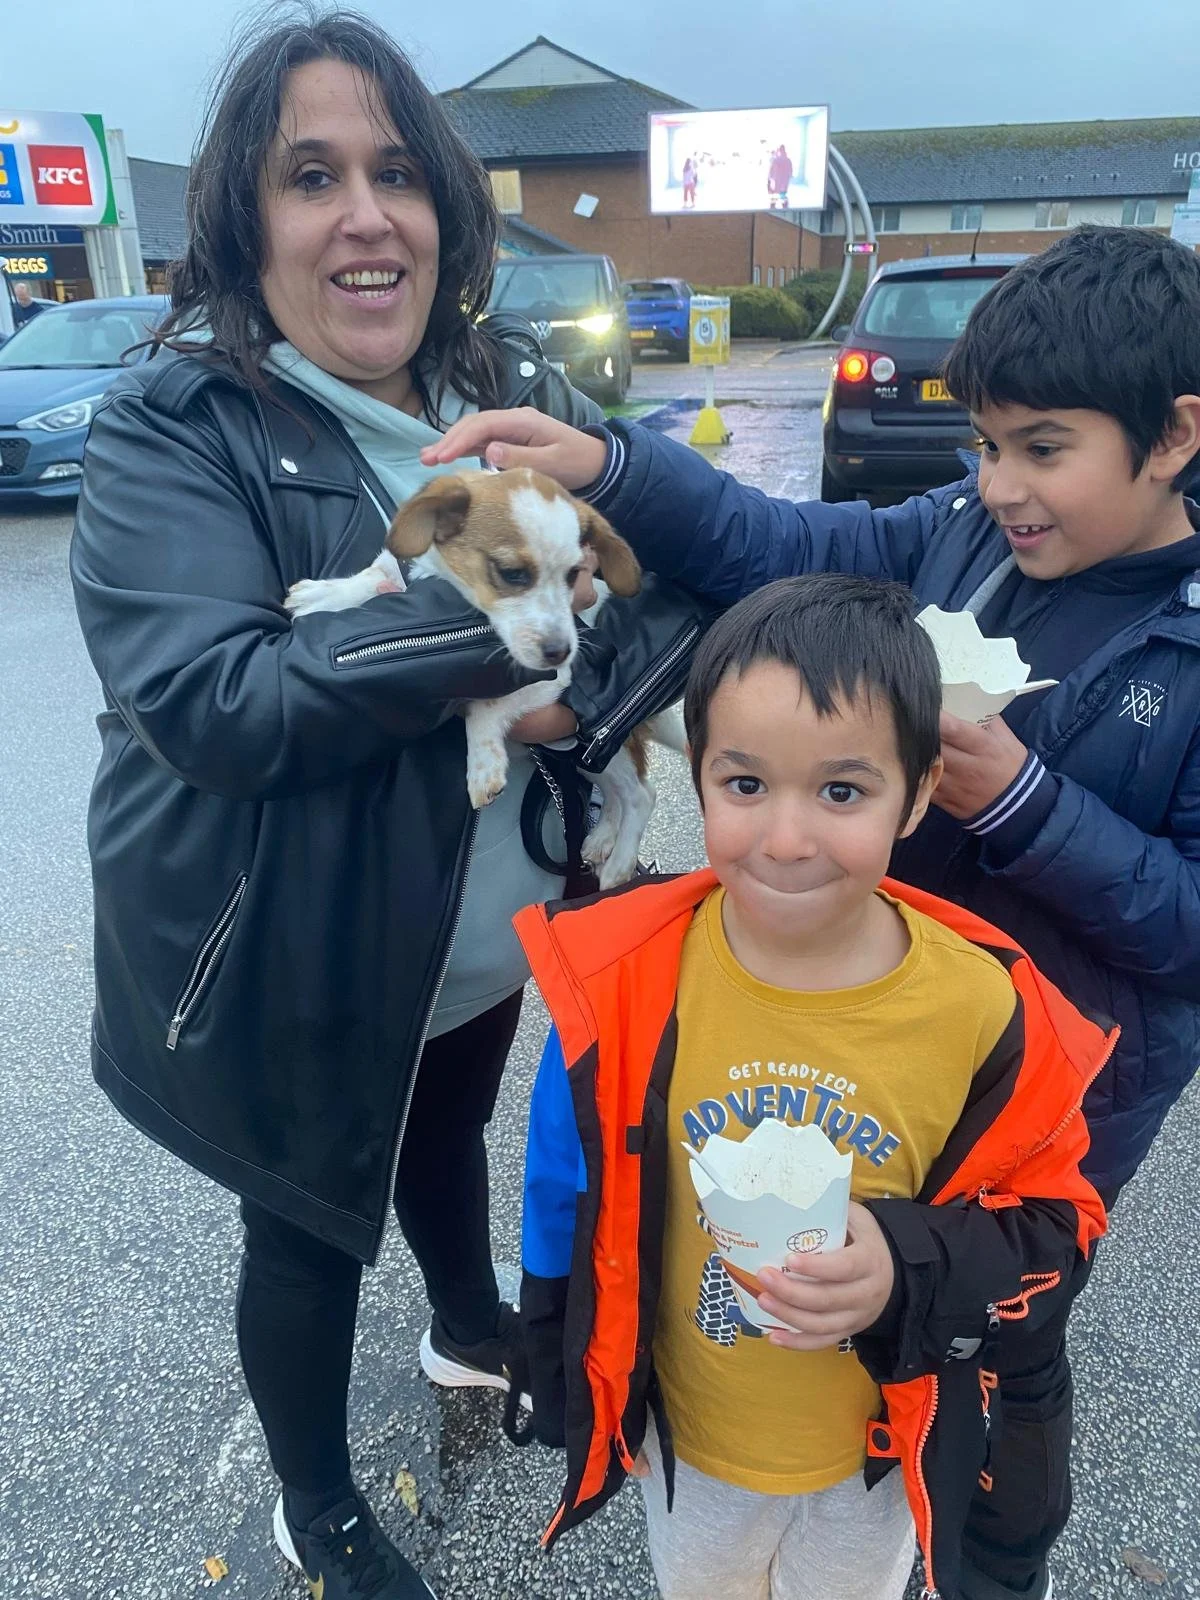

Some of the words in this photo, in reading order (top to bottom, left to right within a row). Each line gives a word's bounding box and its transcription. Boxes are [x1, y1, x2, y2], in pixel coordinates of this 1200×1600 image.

[38, 167, 84, 185] KFC
[1, 223, 58, 244] Smith
[728, 1061, 761, 1081] GET
[767, 1061, 820, 1082] READY
[823, 1072, 858, 1097] FOR
[682, 1082, 901, 1168] ADVENTURE
[727, 1236, 760, 1249] Pretzel
